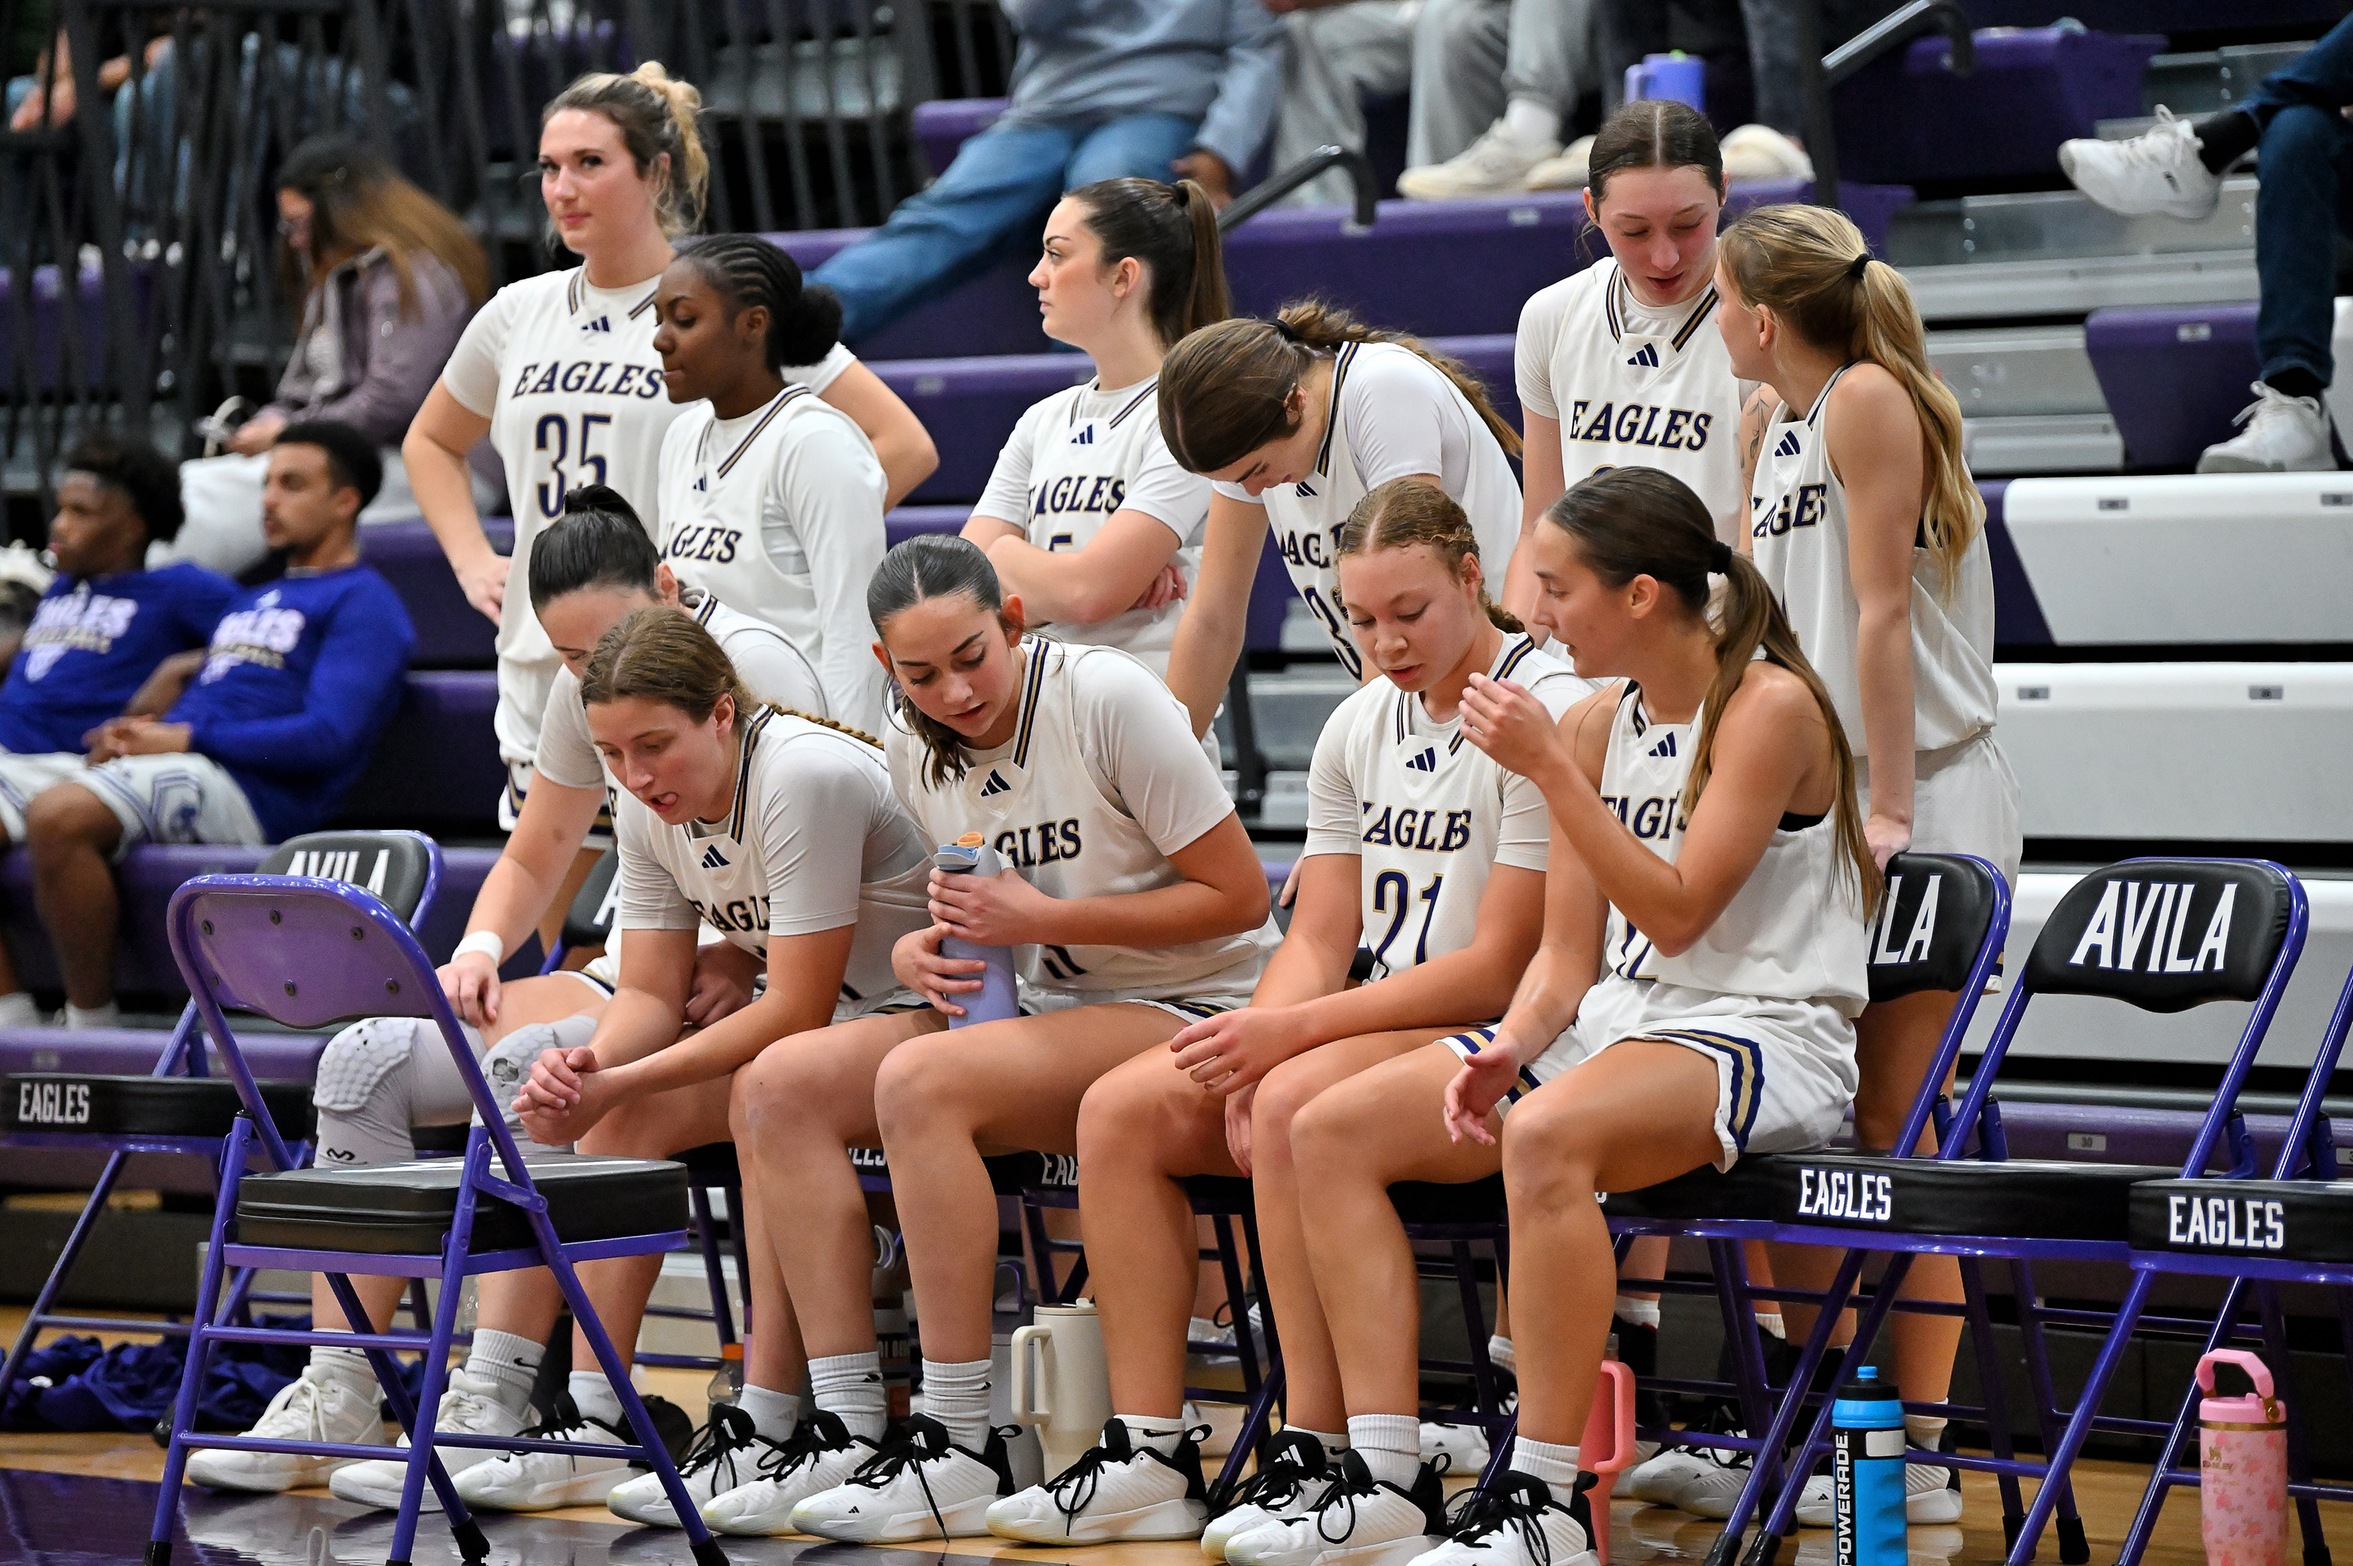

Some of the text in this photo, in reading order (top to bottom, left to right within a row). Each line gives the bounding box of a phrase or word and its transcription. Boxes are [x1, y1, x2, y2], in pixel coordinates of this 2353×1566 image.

[511, 360, 665, 400] EAGLES
[1569, 399, 1714, 453] EAGLES
[535, 412, 612, 519] 35
[1362, 801, 1472, 853] AGLES
[1372, 867, 1444, 980] 21
[2066, 879, 2240, 974] AVILA
[18, 1081, 91, 1124] EAGLES
[1798, 1167, 1893, 1221] EAGLES
[2167, 1195, 2285, 1249] EAGLES
[1835, 1433, 1852, 1566] POWERADE
